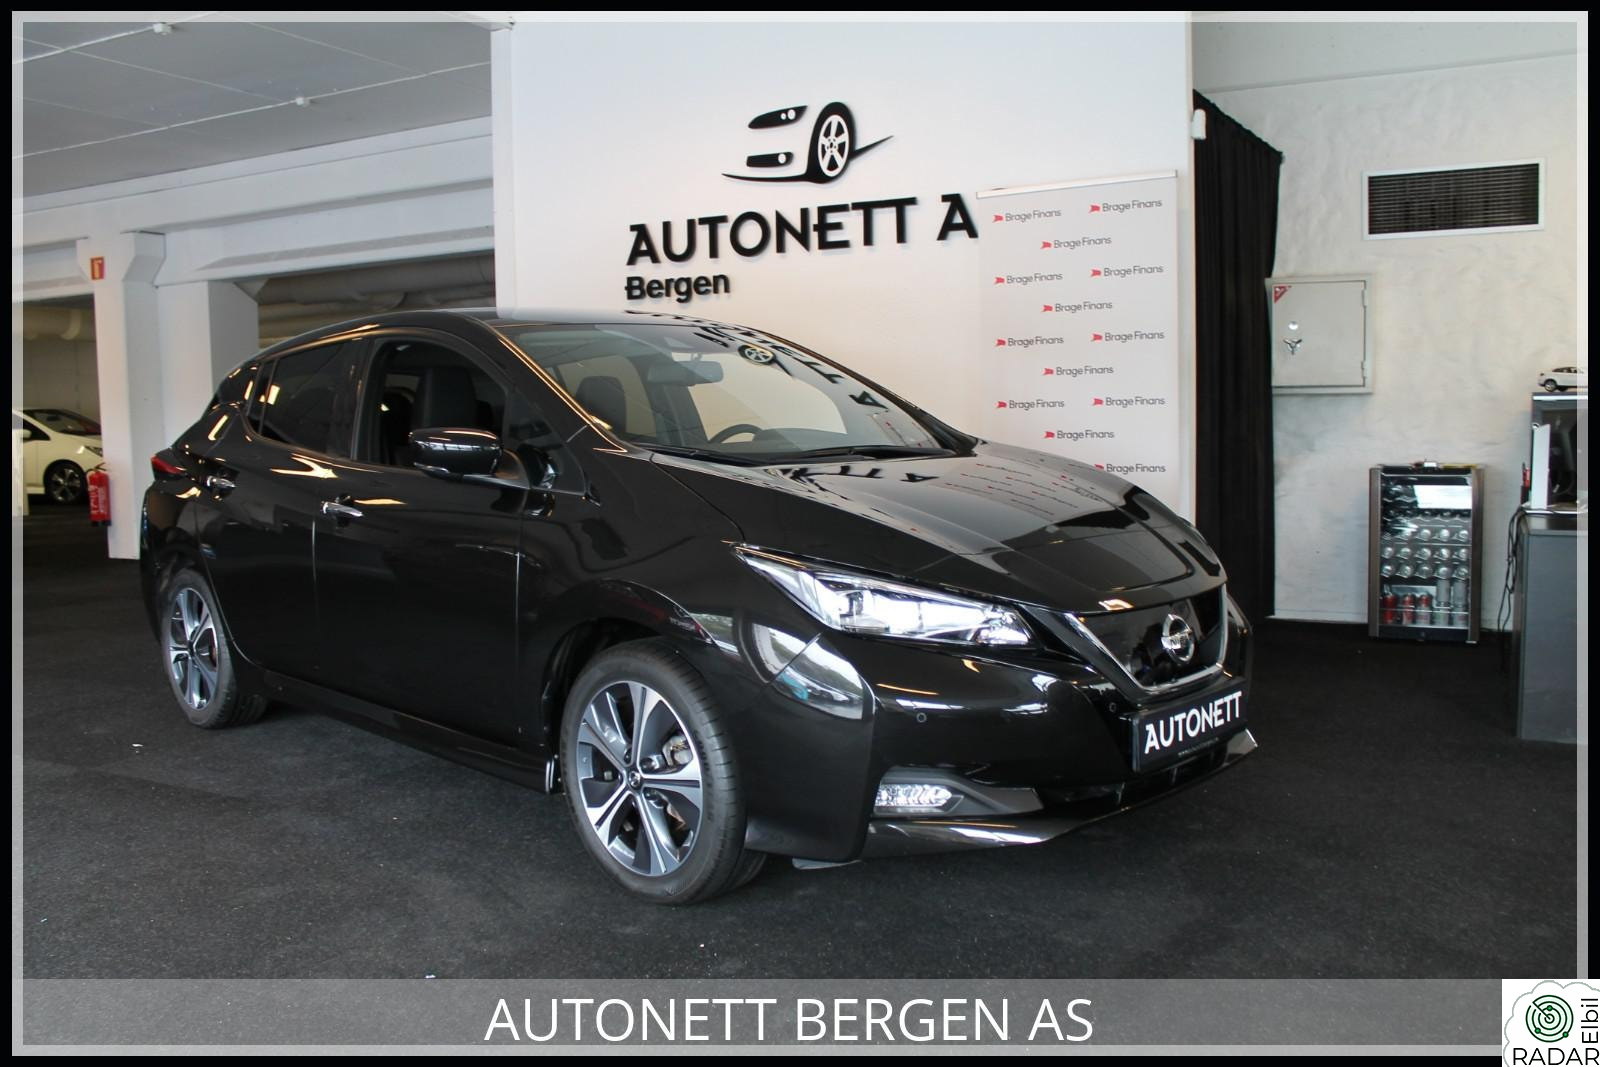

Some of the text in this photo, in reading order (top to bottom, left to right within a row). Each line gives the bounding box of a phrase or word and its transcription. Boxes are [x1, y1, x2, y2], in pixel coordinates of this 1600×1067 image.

[1101, 199, 1163, 214] Brage Finans
[1004, 209, 1062, 224] Brage Finans
[626, 196, 918, 266] AUTONETT
[1053, 236, 1113, 251] Brage Finans
[1006, 272, 1064, 286] Brage Finans
[1103, 265, 1164, 279] Brage Finans
[624, 274, 731, 304] Bergen
[1054, 300, 1113, 314] Brage Finans
[1007, 335, 1065, 349] Brage Finans
[1104, 330, 1166, 344] Brage Finans
[1055, 365, 1115, 378] Brage Finans
[1008, 398, 1065, 412] Brage Finans
[1105, 395, 1166, 409] Brage Finans
[1056, 429, 1115, 442] Brage Finans
[1105, 463, 1167, 475] Brage Finans
[1144, 690, 1242, 754] AUTONETT
